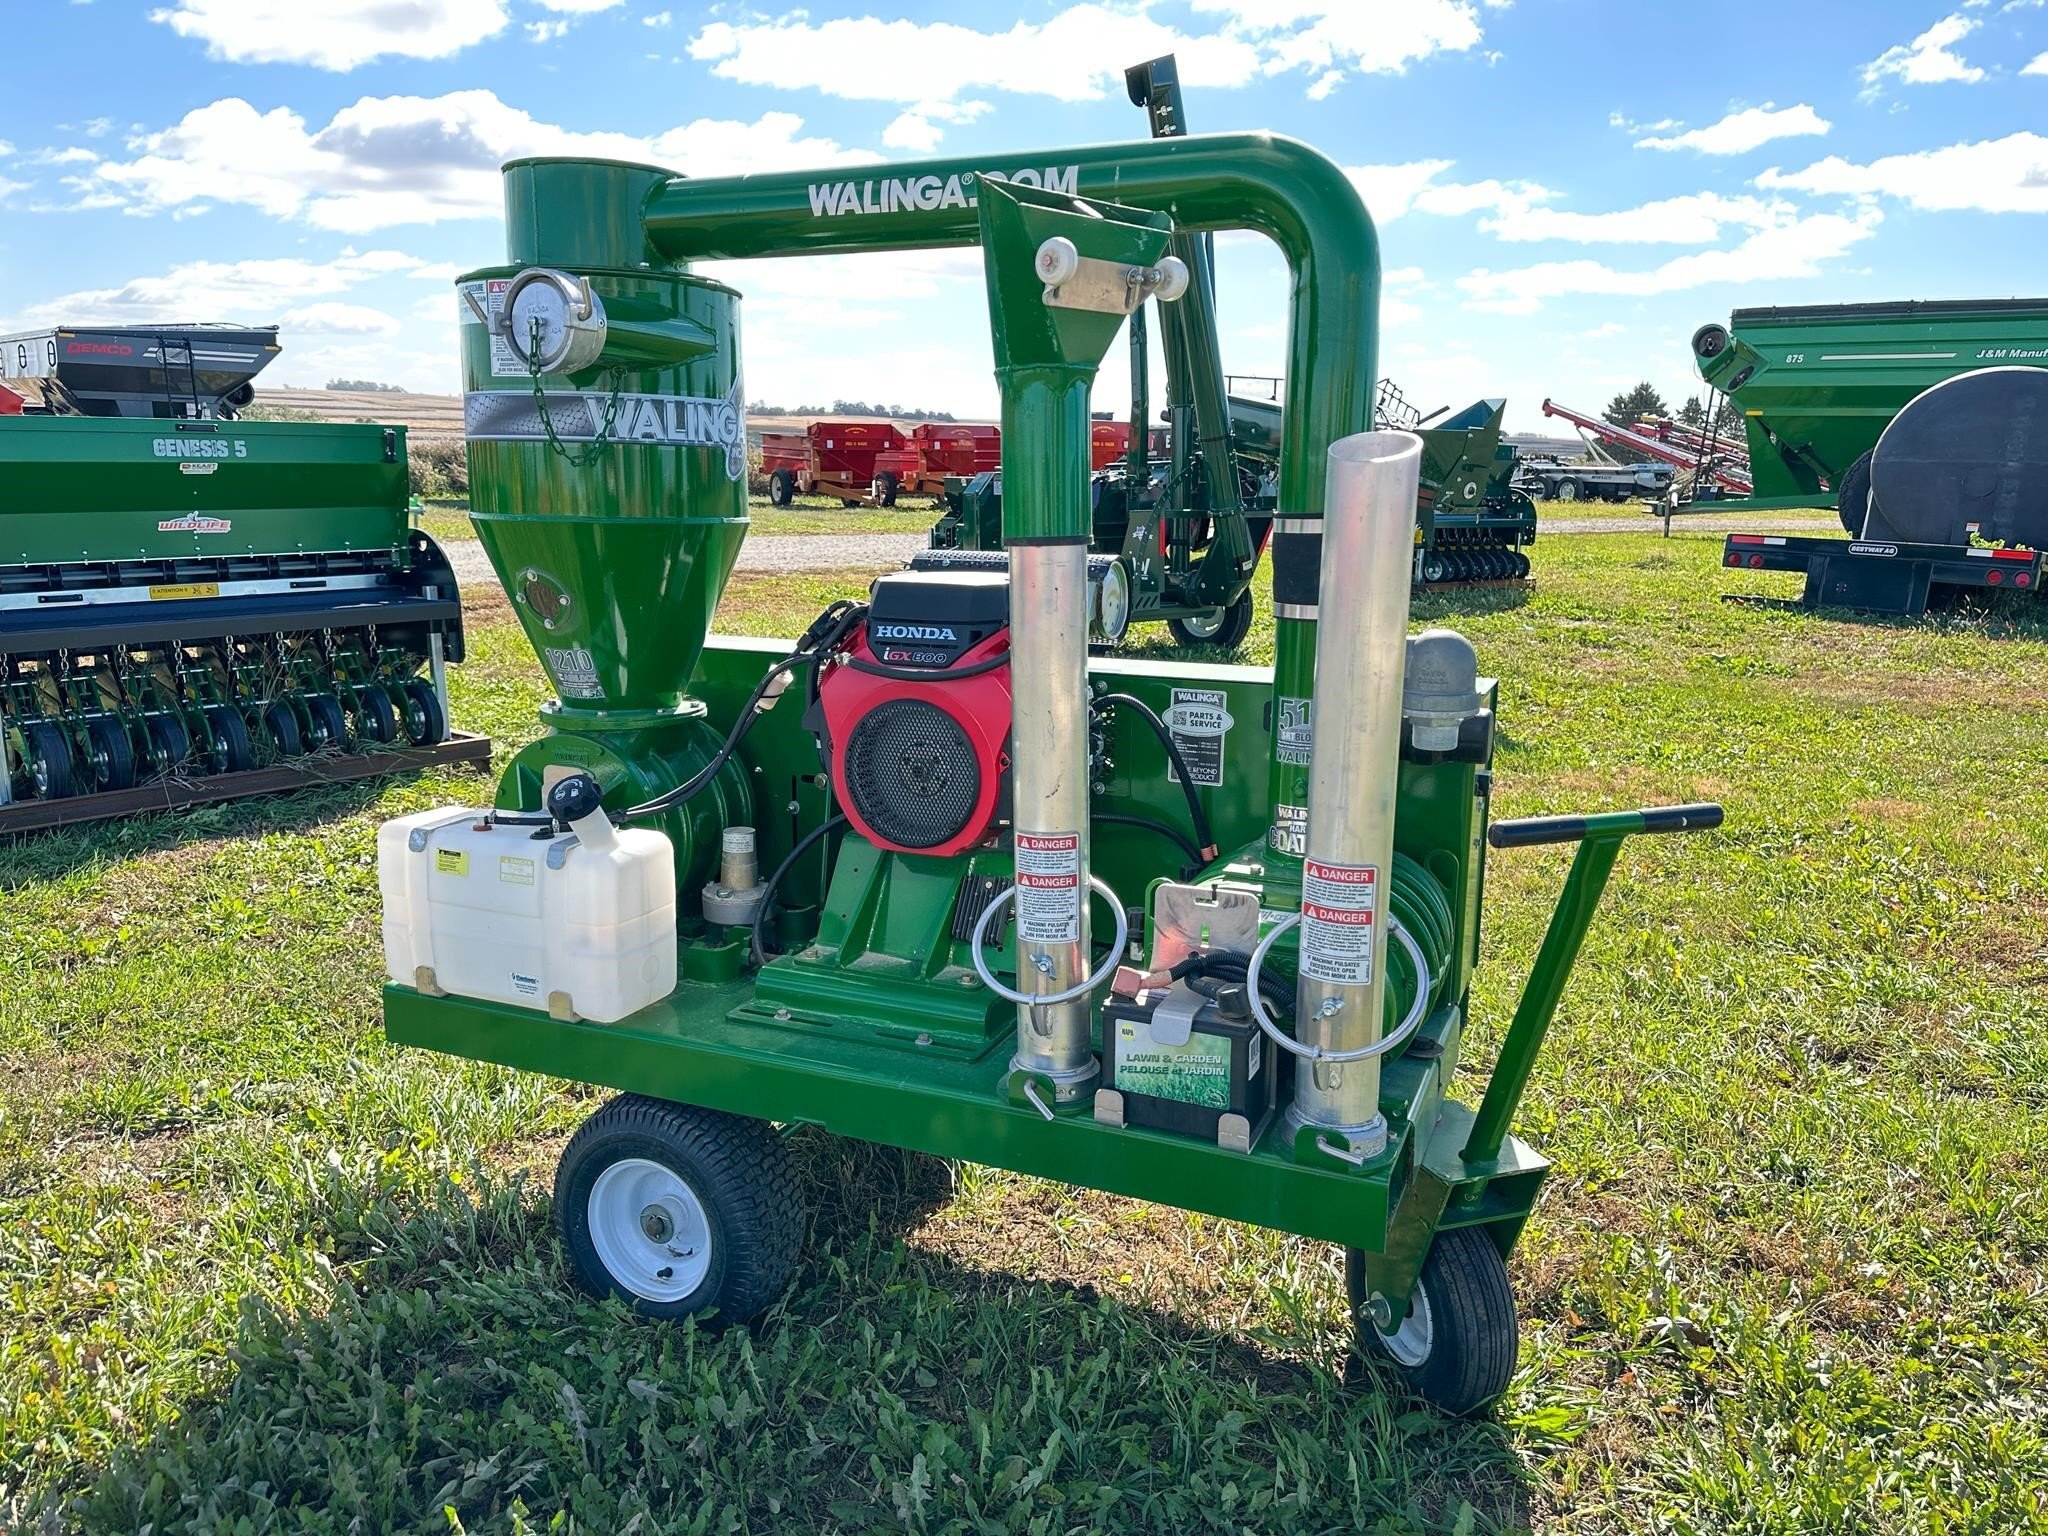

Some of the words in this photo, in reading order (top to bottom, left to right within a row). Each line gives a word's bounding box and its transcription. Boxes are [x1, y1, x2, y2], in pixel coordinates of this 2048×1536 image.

[66, 341, 132, 356] DEMCO
[1976, 349, 2006, 358] J&M
[1785, 354, 1804, 363] 875
[153, 438, 228, 457] GENESIS
[234, 440, 247, 458] 5
[160, 521, 229, 530] WILDLIFE
[1851, 545, 1882, 554] BESTWAY
[876, 625, 957, 641] HONDA
[545, 648, 594, 671] 1210
[884, 647, 947, 663] iGX800
[1177, 692, 1219, 703] WALINGA
[1189, 711, 1214, 720] PARTS
[1190, 720, 1221, 729] SERVICE
[1192, 766, 1217, 775] BEYOND
[1031, 840, 1073, 849] DANGER
[1321, 868, 1369, 881] DANGER
[1031, 877, 1073, 887] DANGER
[1320, 909, 1367, 922] DANGER
[1121, 1028, 1134, 1036] NAPA
[1126, 1053, 1160, 1063] LAWN
[1163, 1055, 1172, 1063] &
[1174, 1054, 1222, 1064] GARDEN
[1120, 1065, 1169, 1075] PELOUSE
[1183, 1066, 1225, 1076] JARDIN
